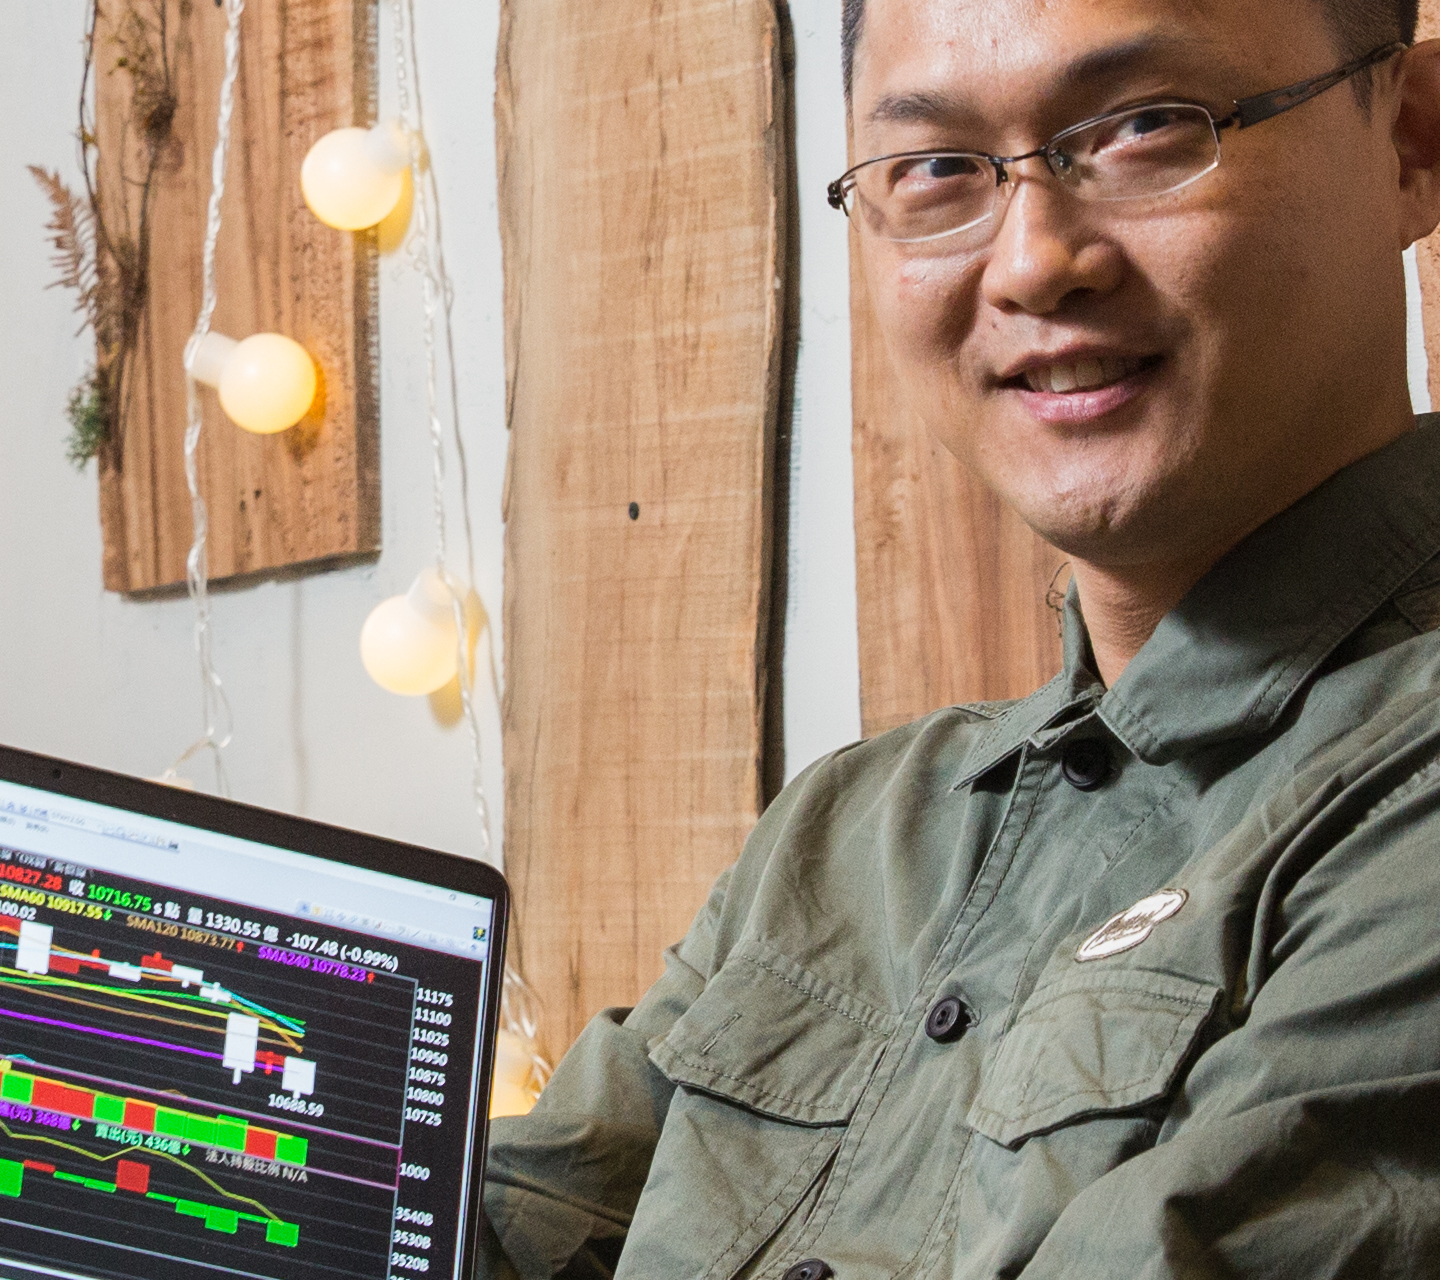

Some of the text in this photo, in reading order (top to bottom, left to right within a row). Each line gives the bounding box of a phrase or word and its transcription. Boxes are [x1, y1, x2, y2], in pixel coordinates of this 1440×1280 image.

[0, 864, 61, 889] 10827.28
[88, 885, 150, 910] 10716.75
[206, 913, 259, 937] 1330.55
[286, 933, 337, 955] -107.48
[340, 945, 397, 971] (-0.99%)
[417, 988, 452, 1006] 11175
[415, 1007, 451, 1025] 11100
[413, 1028, 448, 1046] 11025
[411, 1047, 447, 1065] 10950
[410, 1067, 444, 1085] 10875
[408, 1087, 443, 1105] 10800
[406, 1107, 441, 1125] 10725
[400, 1163, 429, 1180] 1000
[396, 1207, 432, 1225] 3540B
[393, 1230, 430, 1248] 3530B
[391, 1252, 428, 1271] 3520B
